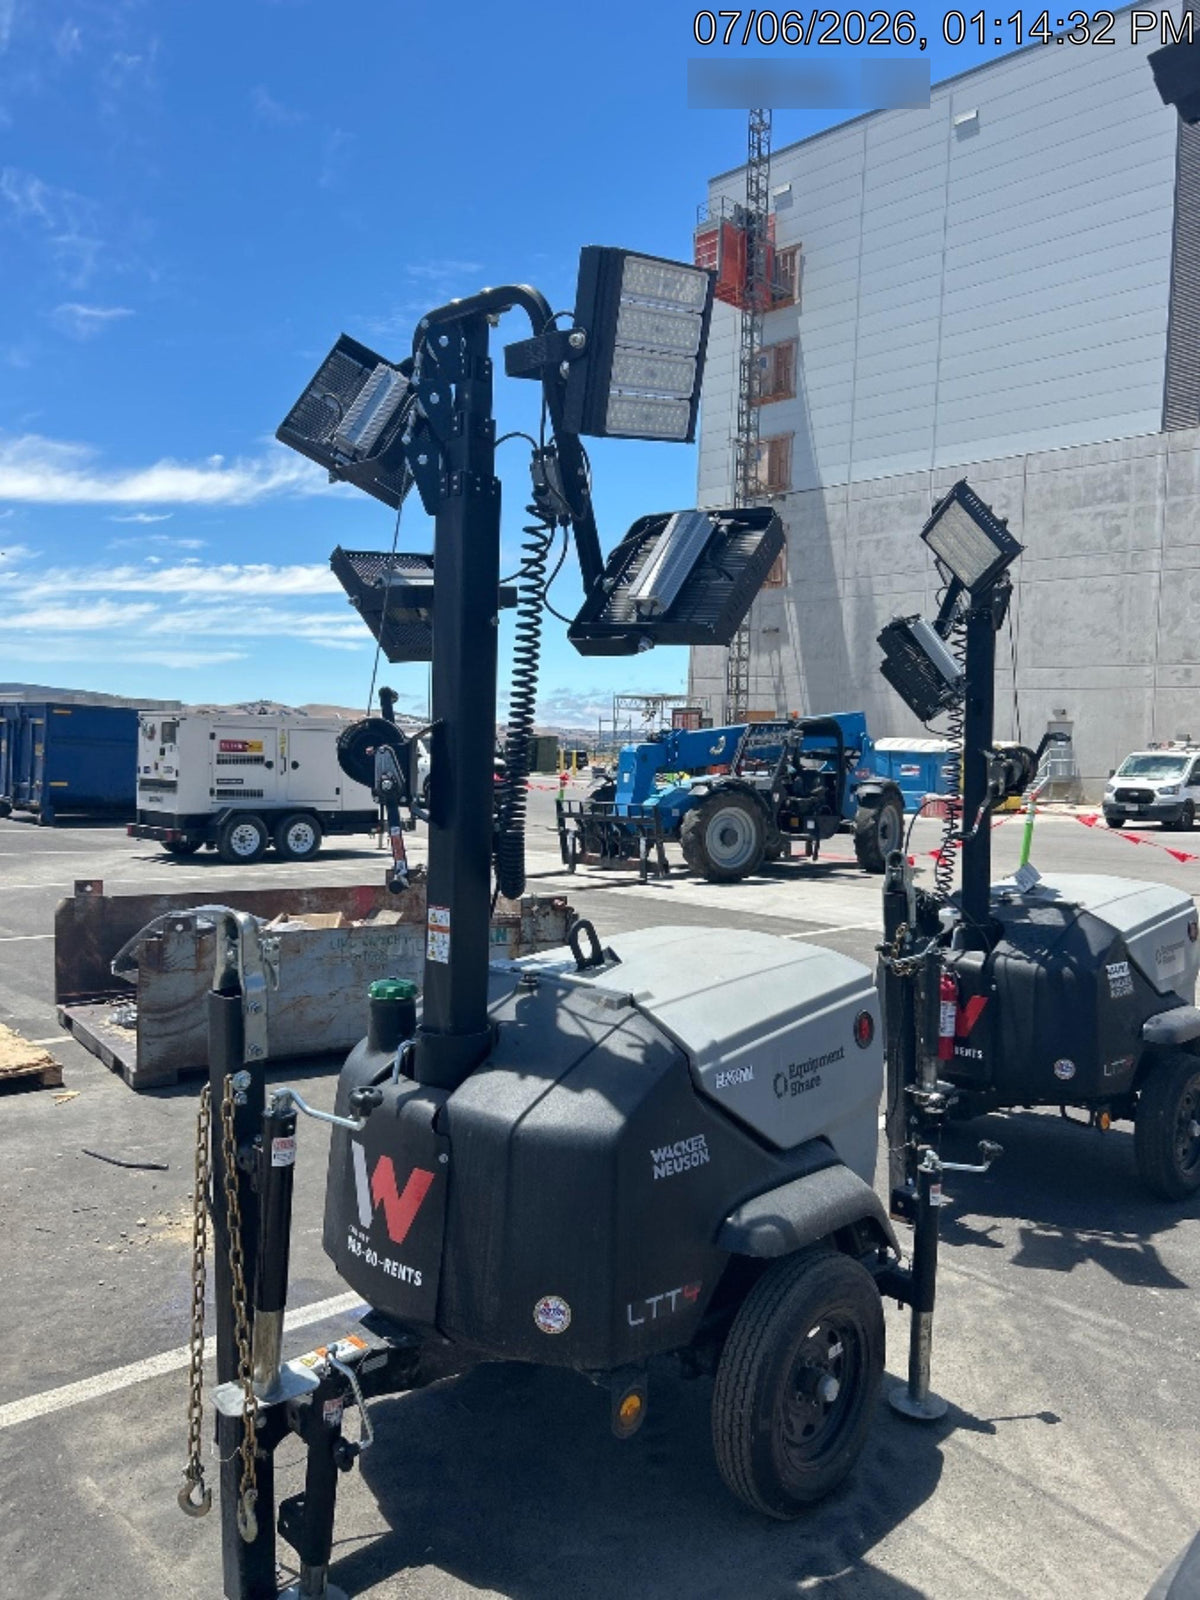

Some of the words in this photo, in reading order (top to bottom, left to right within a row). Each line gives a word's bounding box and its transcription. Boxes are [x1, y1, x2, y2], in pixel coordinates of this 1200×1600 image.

[788, 1046, 845, 1080] Equipment
[790, 1074, 822, 1097] Share
[650, 1133, 707, 1164] WACKER
[653, 1147, 710, 1180] NEUSON
